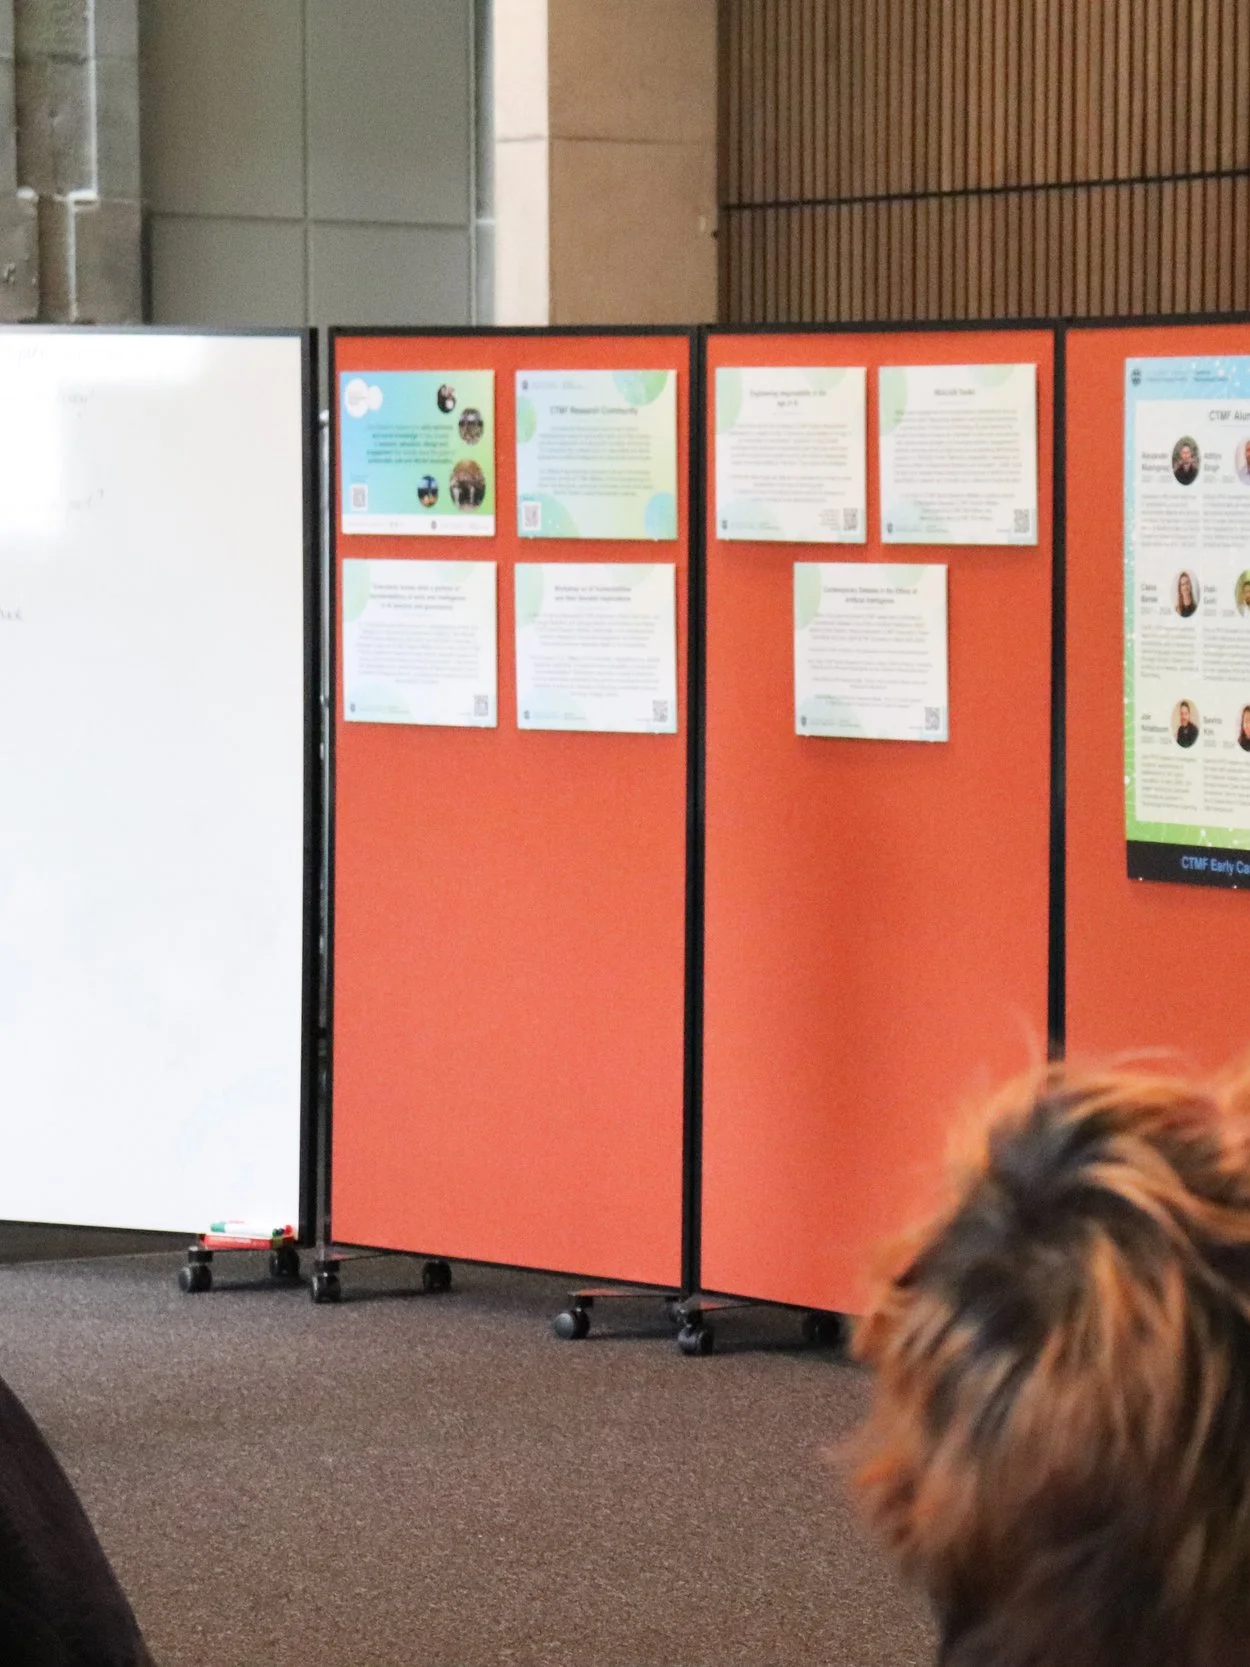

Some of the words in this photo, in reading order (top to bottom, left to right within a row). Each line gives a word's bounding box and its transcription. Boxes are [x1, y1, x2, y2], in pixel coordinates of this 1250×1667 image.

[1208, 410, 1232, 422] CTMF
[1181, 855, 1209, 869] CTMF
[1210, 857, 1234, 875] Early
